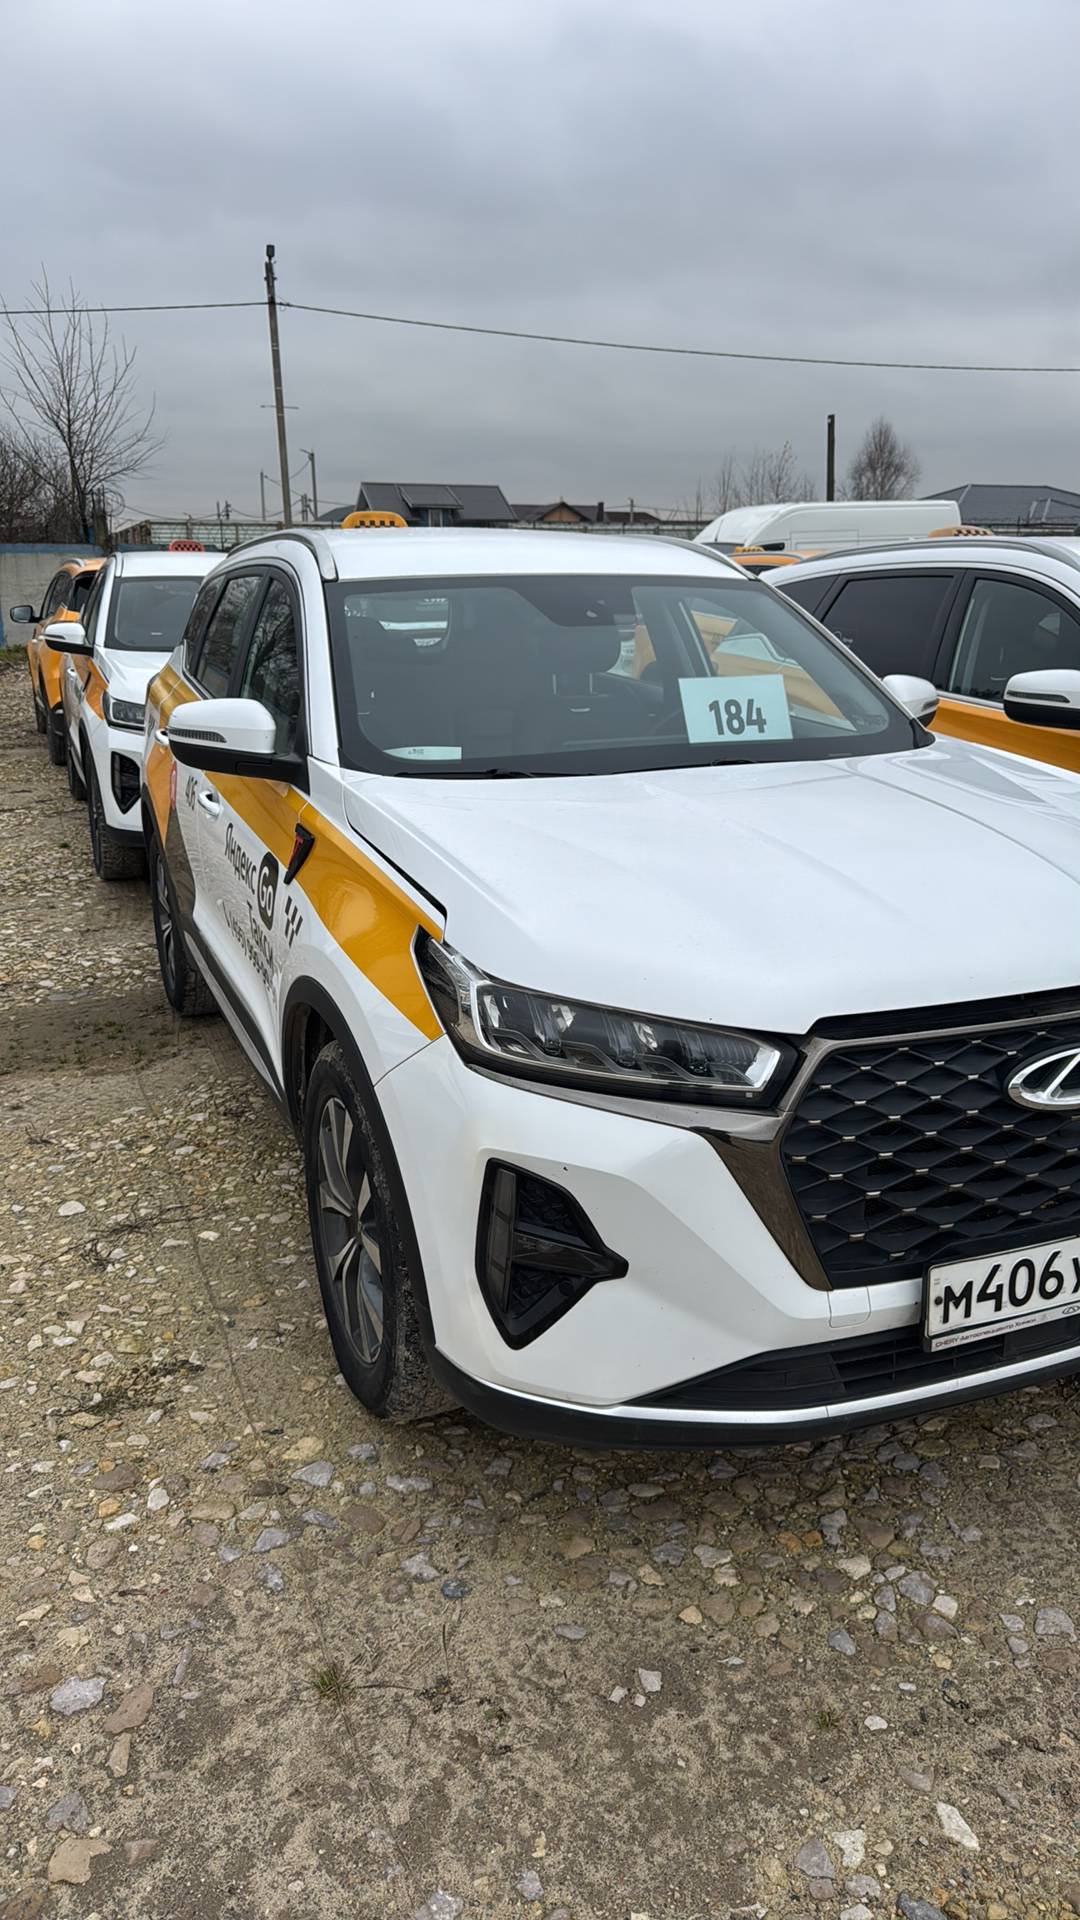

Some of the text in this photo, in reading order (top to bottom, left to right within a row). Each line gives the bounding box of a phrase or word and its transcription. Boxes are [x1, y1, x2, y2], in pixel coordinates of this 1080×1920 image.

[708, 698, 767, 736] 184
[224, 822, 274, 917] Яндекс Go
